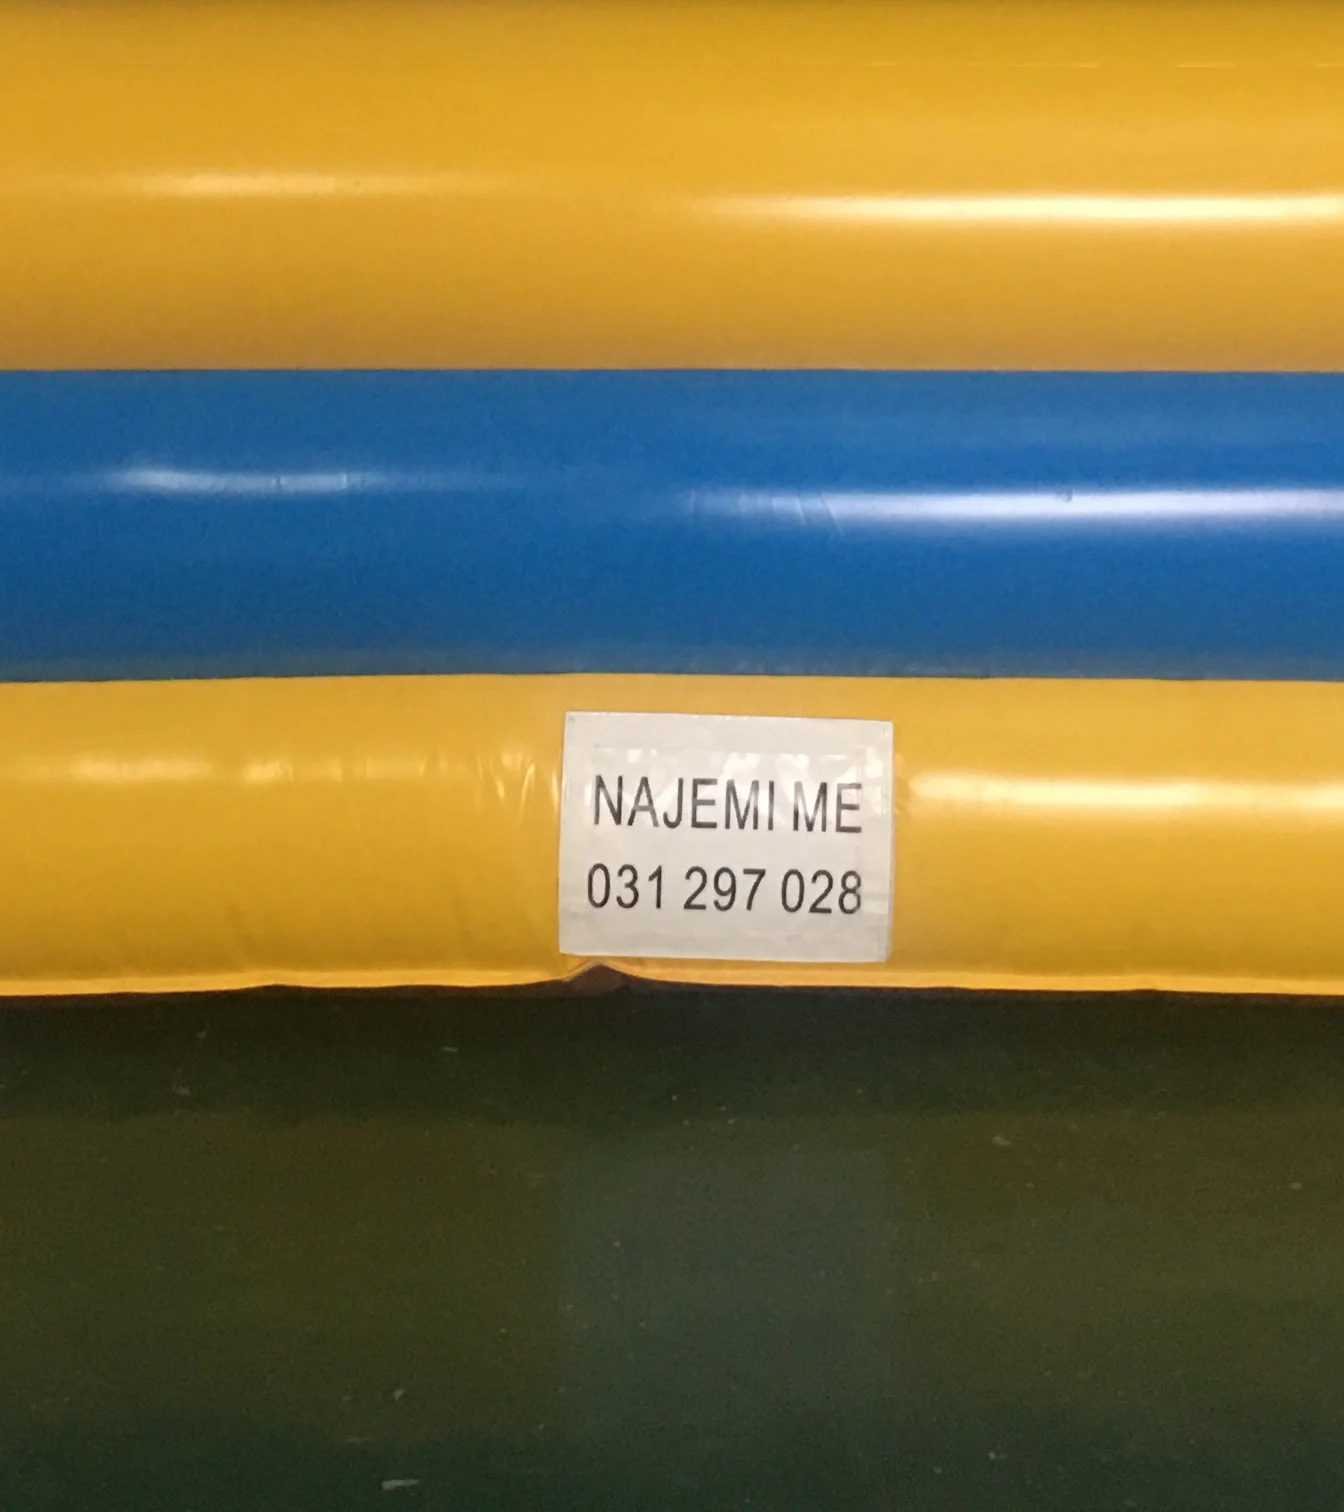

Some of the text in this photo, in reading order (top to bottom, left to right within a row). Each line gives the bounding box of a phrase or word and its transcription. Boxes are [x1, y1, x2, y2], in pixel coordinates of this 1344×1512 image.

[593, 774, 862, 833] NAJEMI ME
[587, 863, 862, 915] 031 297 028
